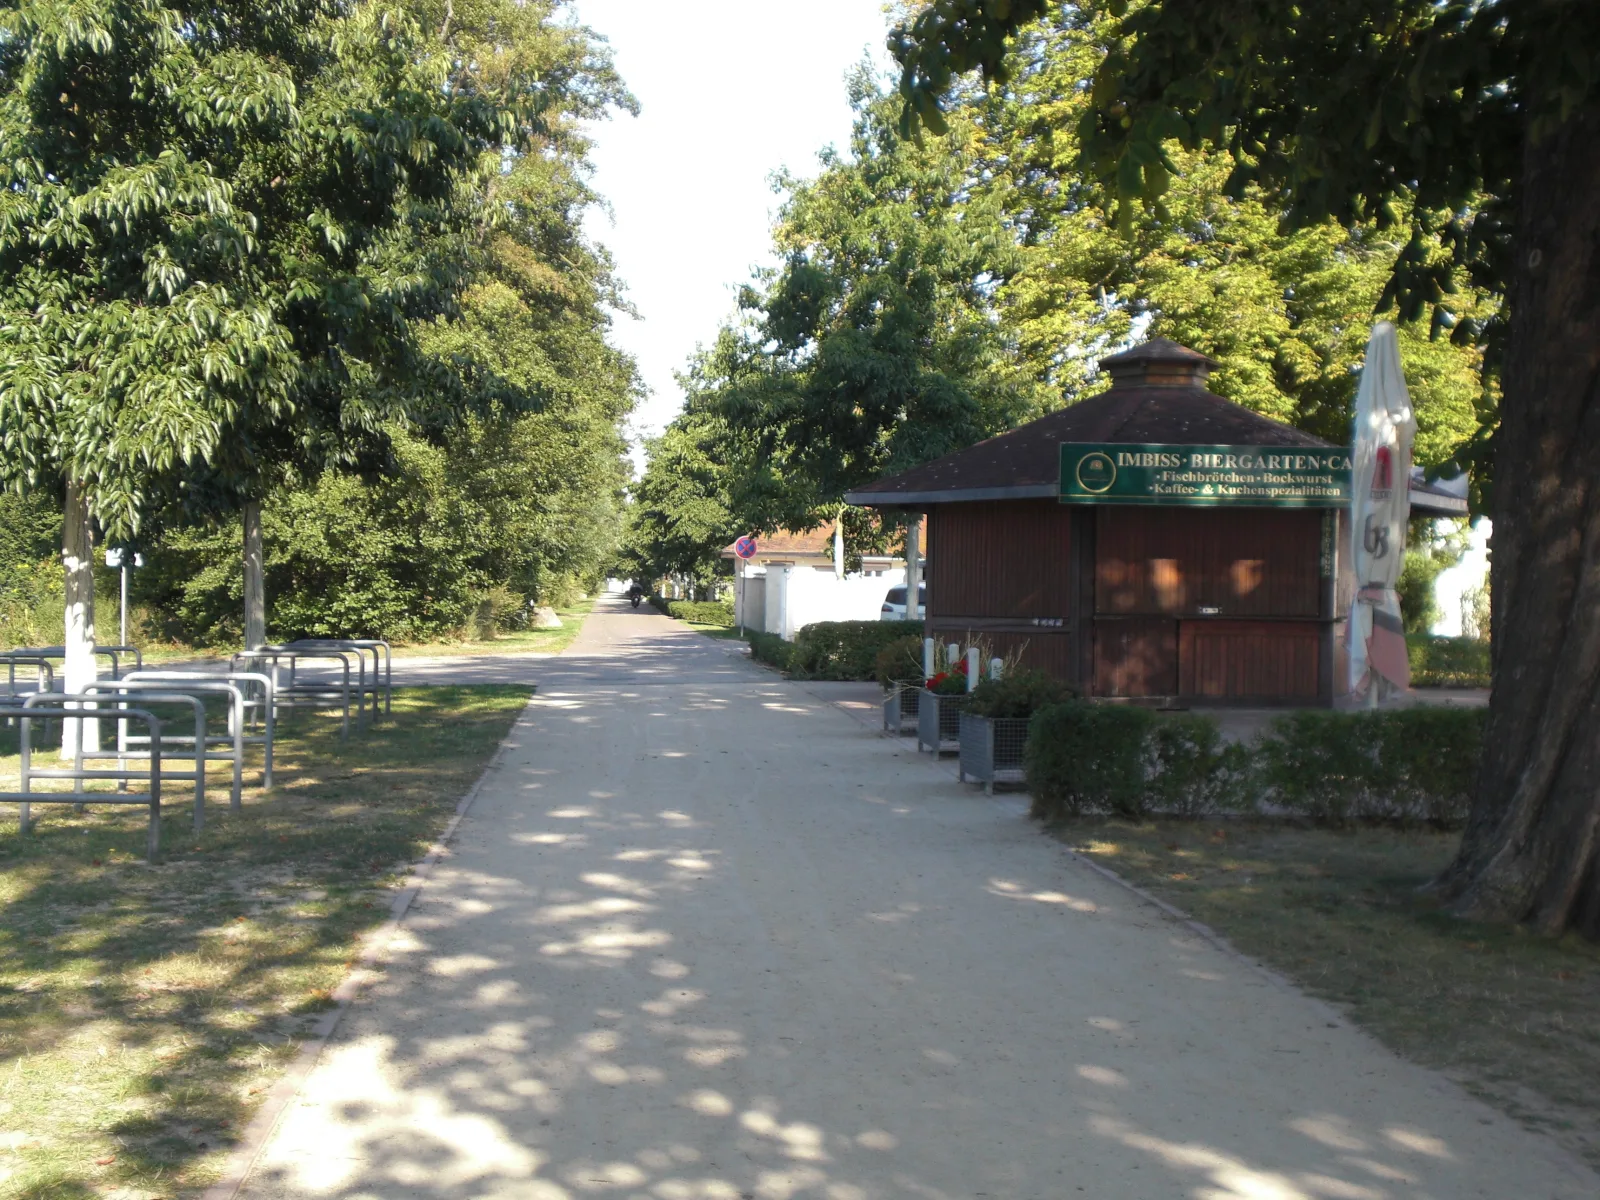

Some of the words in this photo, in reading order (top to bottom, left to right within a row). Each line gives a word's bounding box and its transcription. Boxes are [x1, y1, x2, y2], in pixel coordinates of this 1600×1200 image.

[1117, 452, 1181, 467] IMBISS
[1191, 453, 1321, 470] BIERGARTEN
[1327, 455, 1353, 470] CA
[1162, 471, 1255, 483] Fischbrötchen
[1263, 472, 1333, 484] Bockwurst
[1154, 483, 1200, 494] Kaffee-
[1202, 483, 1214, 495] &
[1217, 483, 1341, 497] Kuchenspezialitäten
